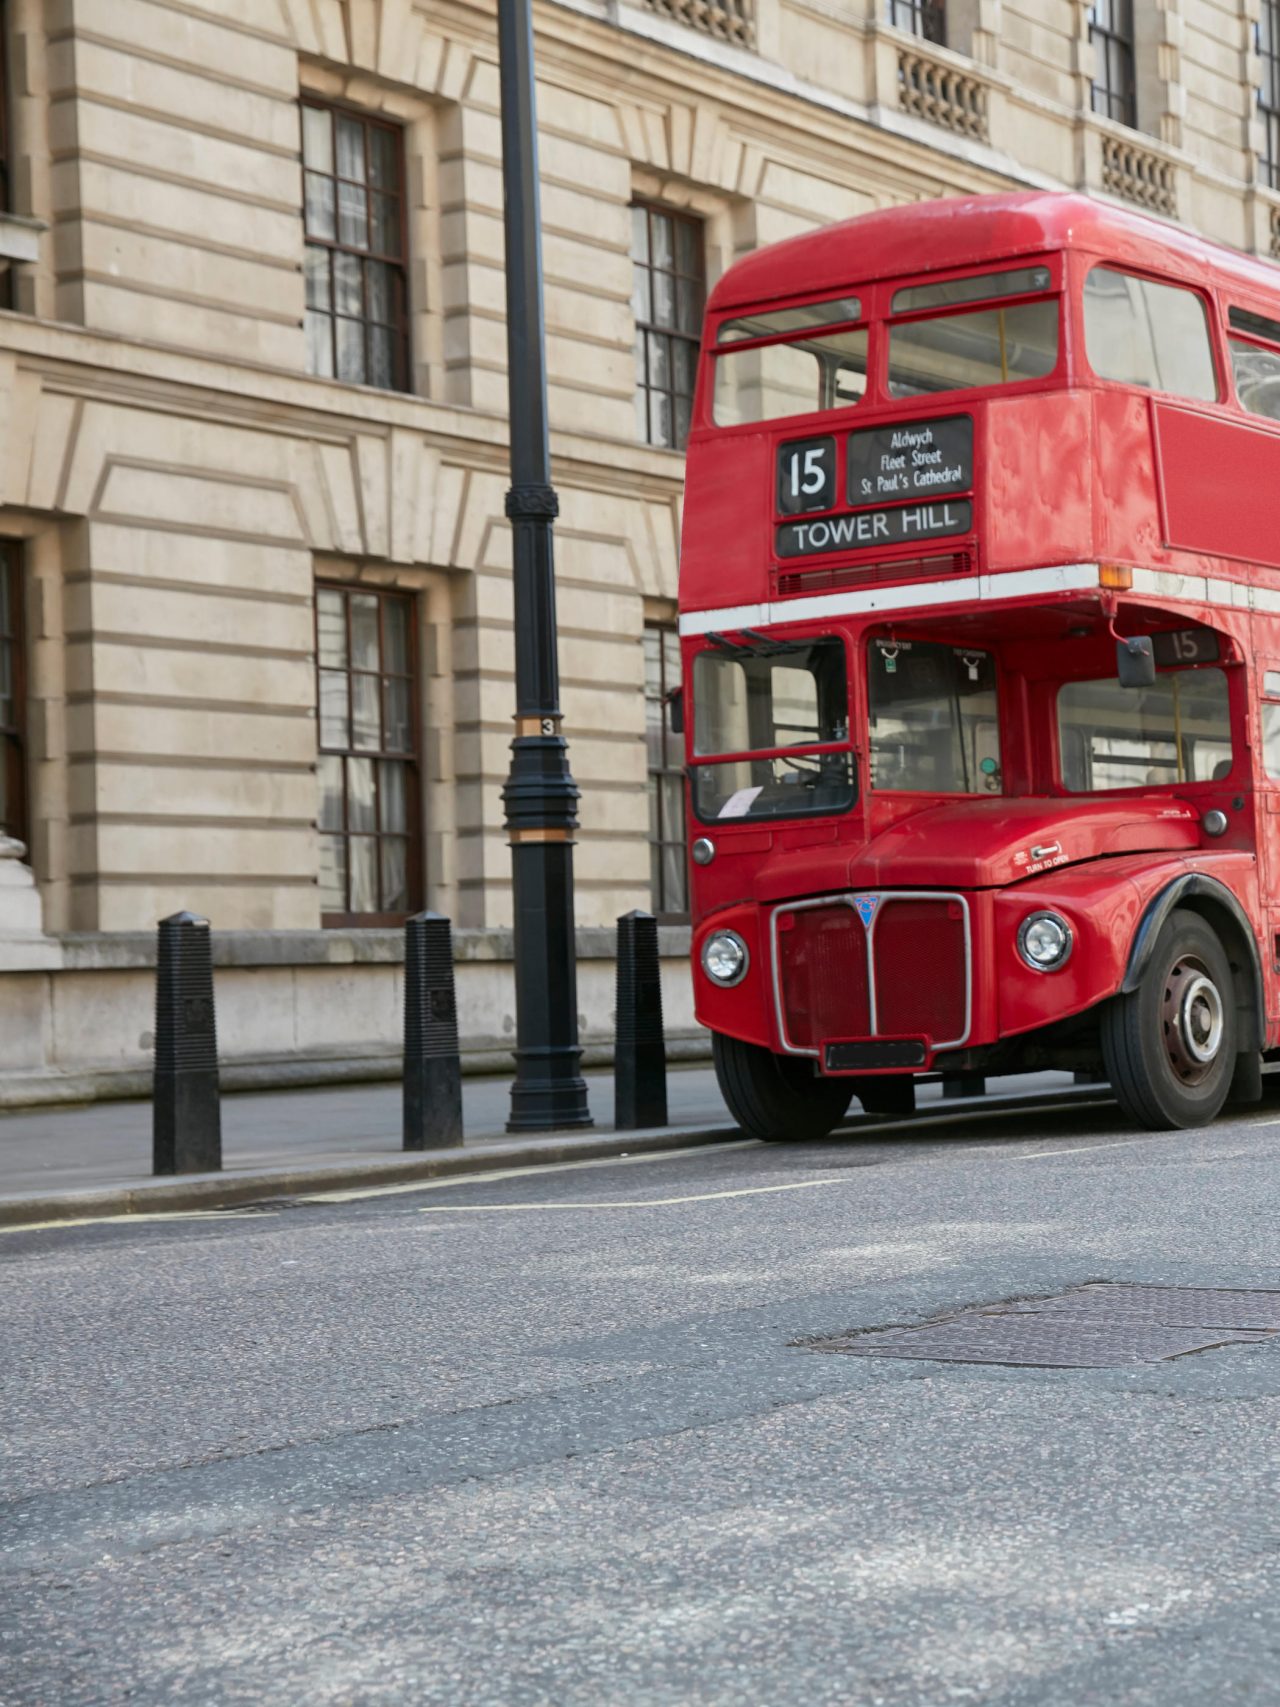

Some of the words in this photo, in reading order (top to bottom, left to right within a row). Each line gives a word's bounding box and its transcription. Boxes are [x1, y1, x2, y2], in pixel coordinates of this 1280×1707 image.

[891, 428, 933, 449] Aldwych
[790, 447, 826, 497] 15
[881, 454, 906, 471] Fleet
[911, 449, 942, 467] Street
[861, 478, 872, 494] St
[877, 473, 909, 491] Paul's
[914, 465, 962, 487] Cathedral
[792, 513, 889, 550] TOWER
[902, 504, 959, 533] HILL
[1172, 630, 1198, 659] 15
[1025, 862, 1043, 873] TURN
[1043, 859, 1053, 868] TO
[1052, 854, 1069, 864] OPEN
